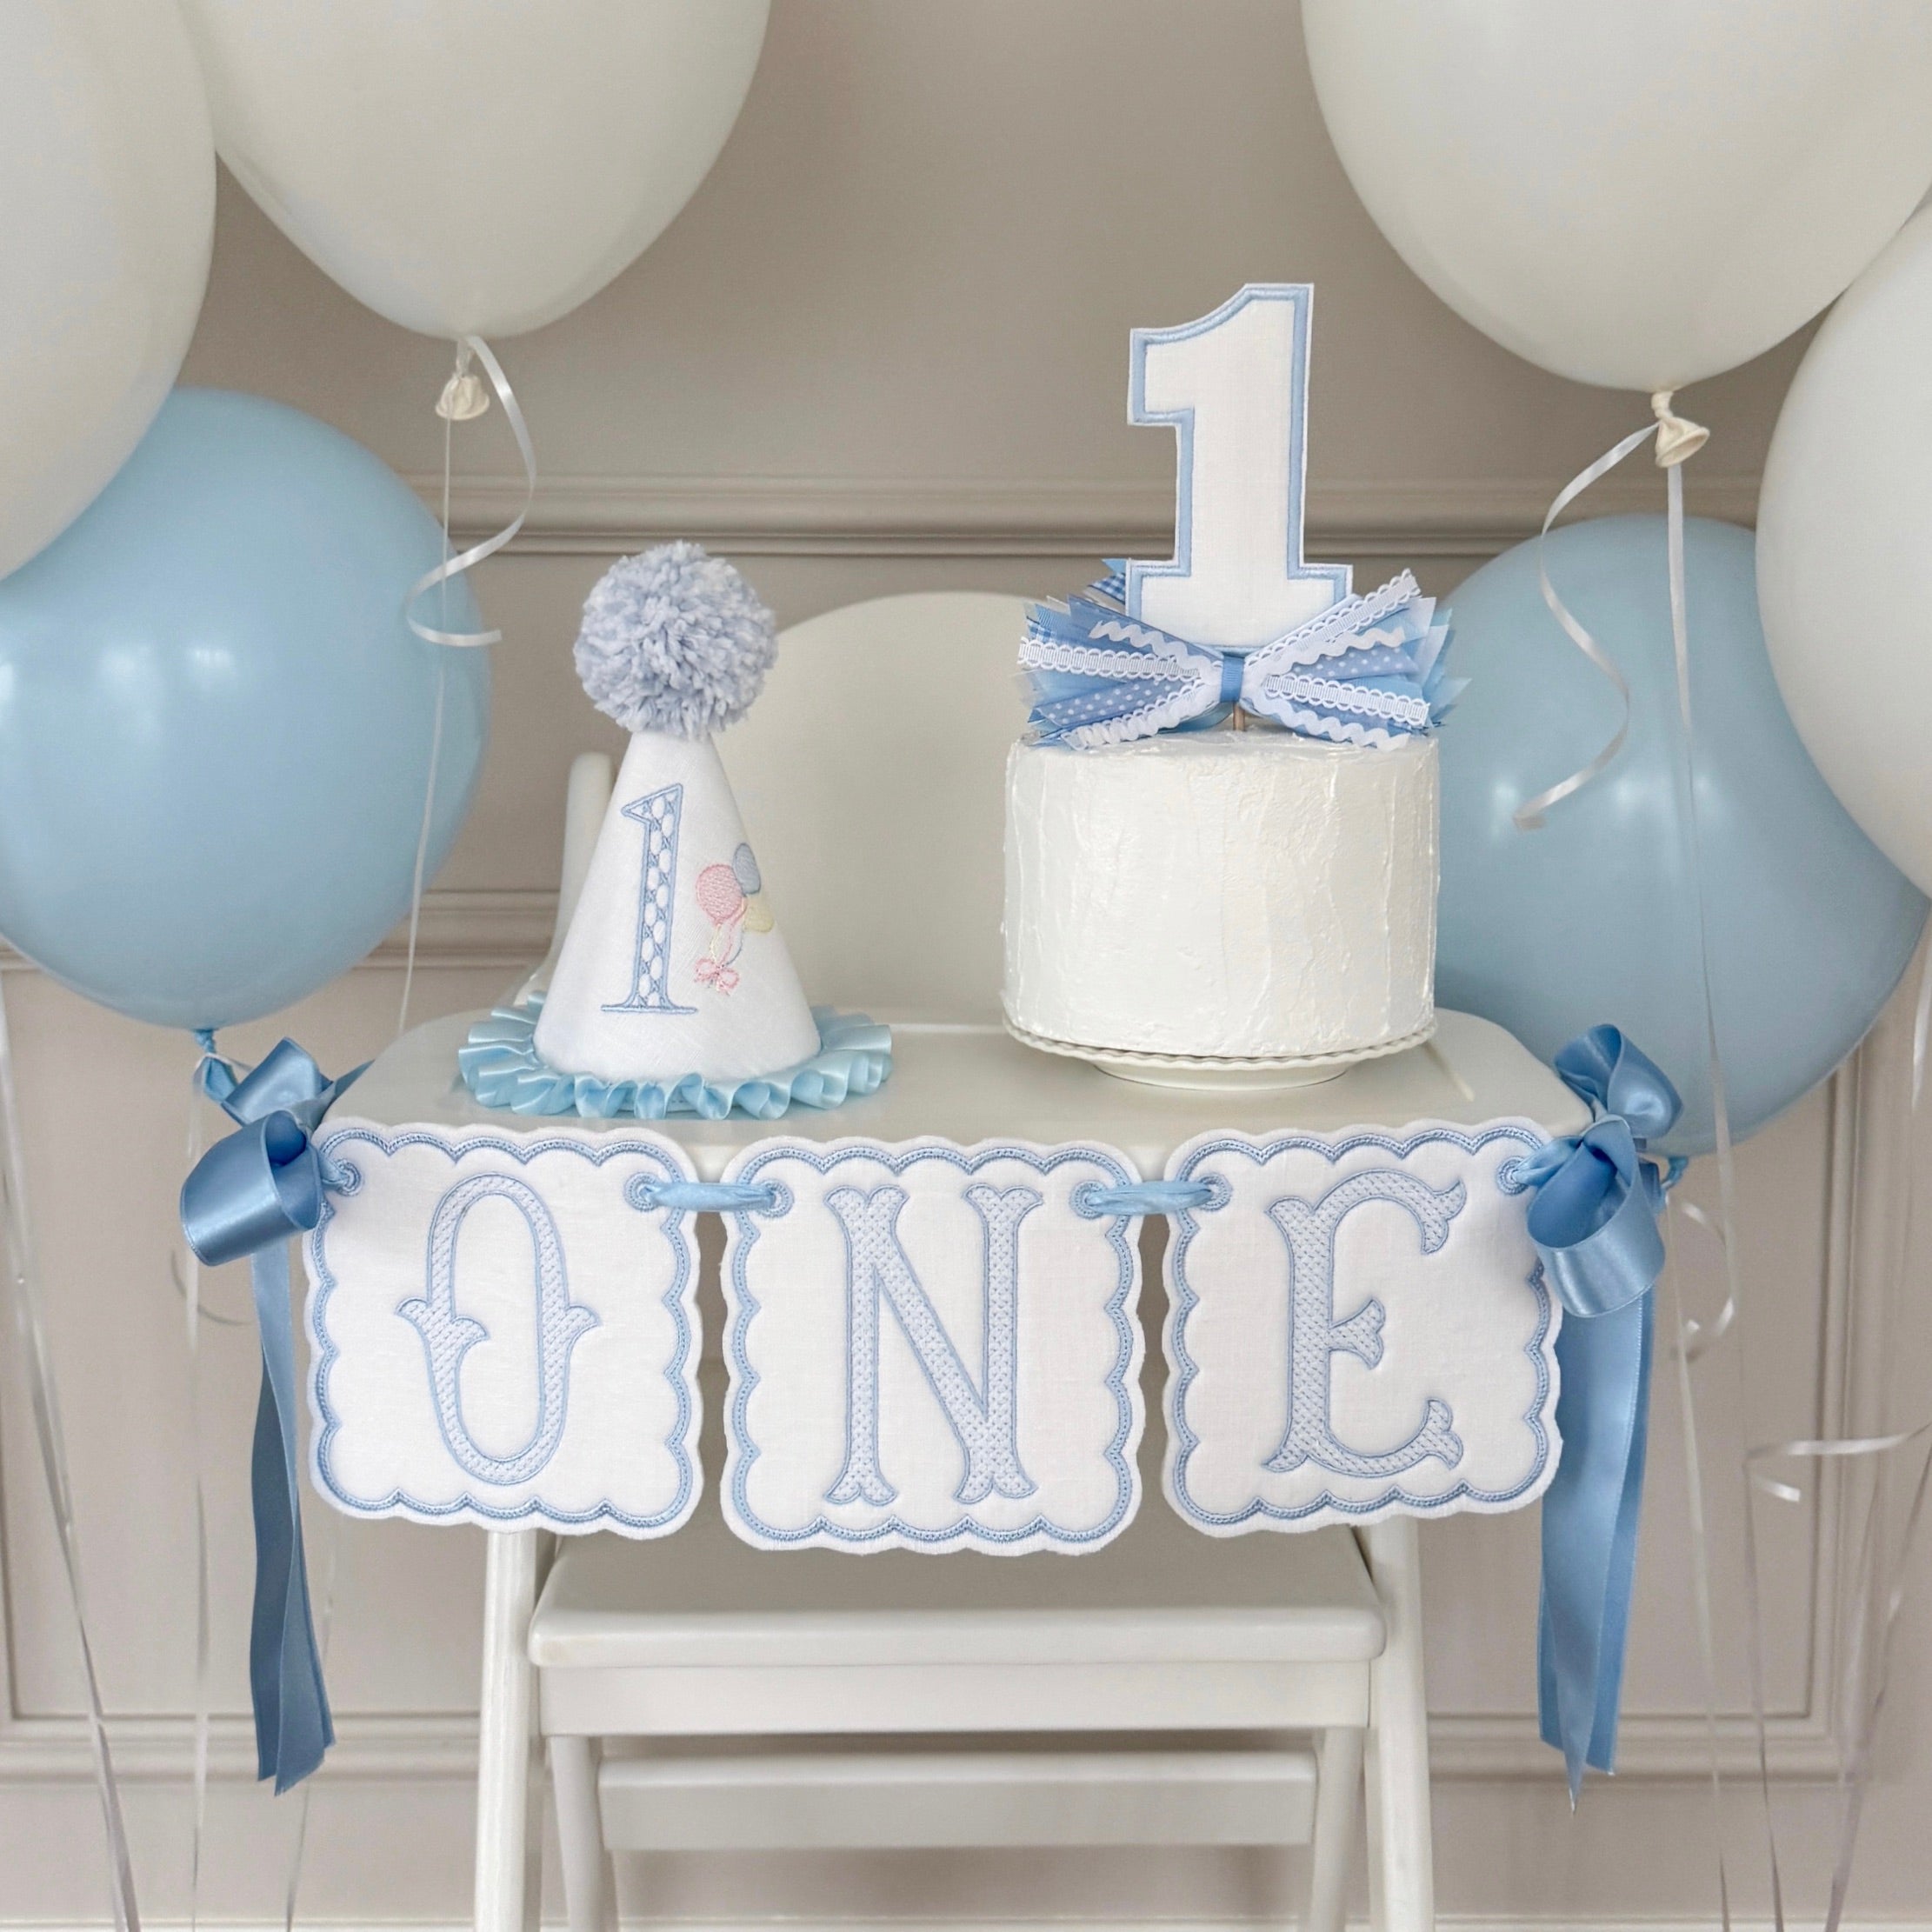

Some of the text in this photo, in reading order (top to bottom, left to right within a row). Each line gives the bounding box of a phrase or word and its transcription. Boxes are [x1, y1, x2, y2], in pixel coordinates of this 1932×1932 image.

[1128, 283, 1353, 647] 1
[601, 783, 698, 1013] 1
[397, 1169, 1467, 1504] ONE
